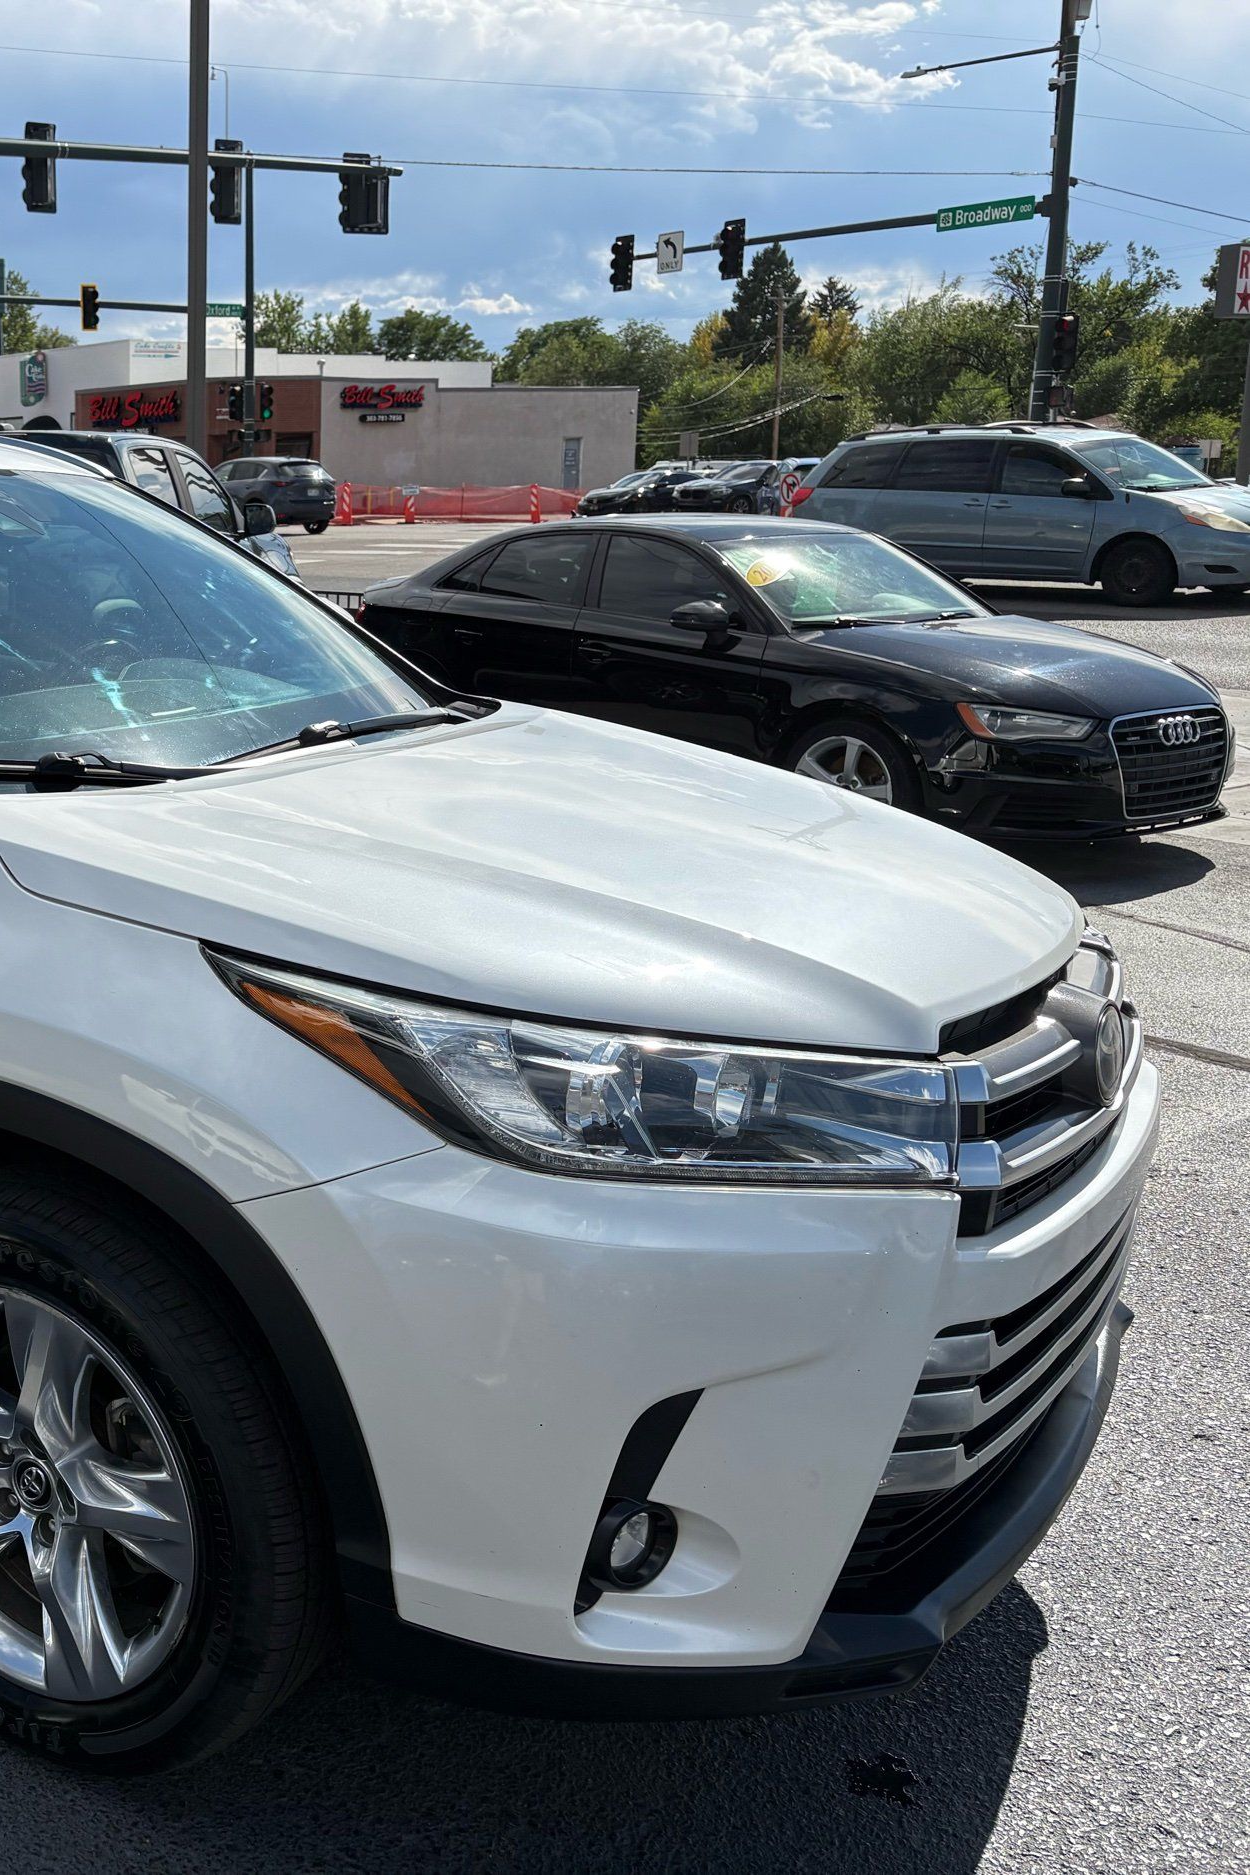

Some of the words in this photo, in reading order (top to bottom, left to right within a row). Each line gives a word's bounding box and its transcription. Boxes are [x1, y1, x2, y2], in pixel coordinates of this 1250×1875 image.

[955, 205, 1017, 226] Broadway
[660, 260, 679, 271] ONLY
[340, 384, 374, 404] Bill
[377, 383, 425, 409] Smith
[89, 395, 120, 421] Bill
[121, 390, 177, 427] Smith
